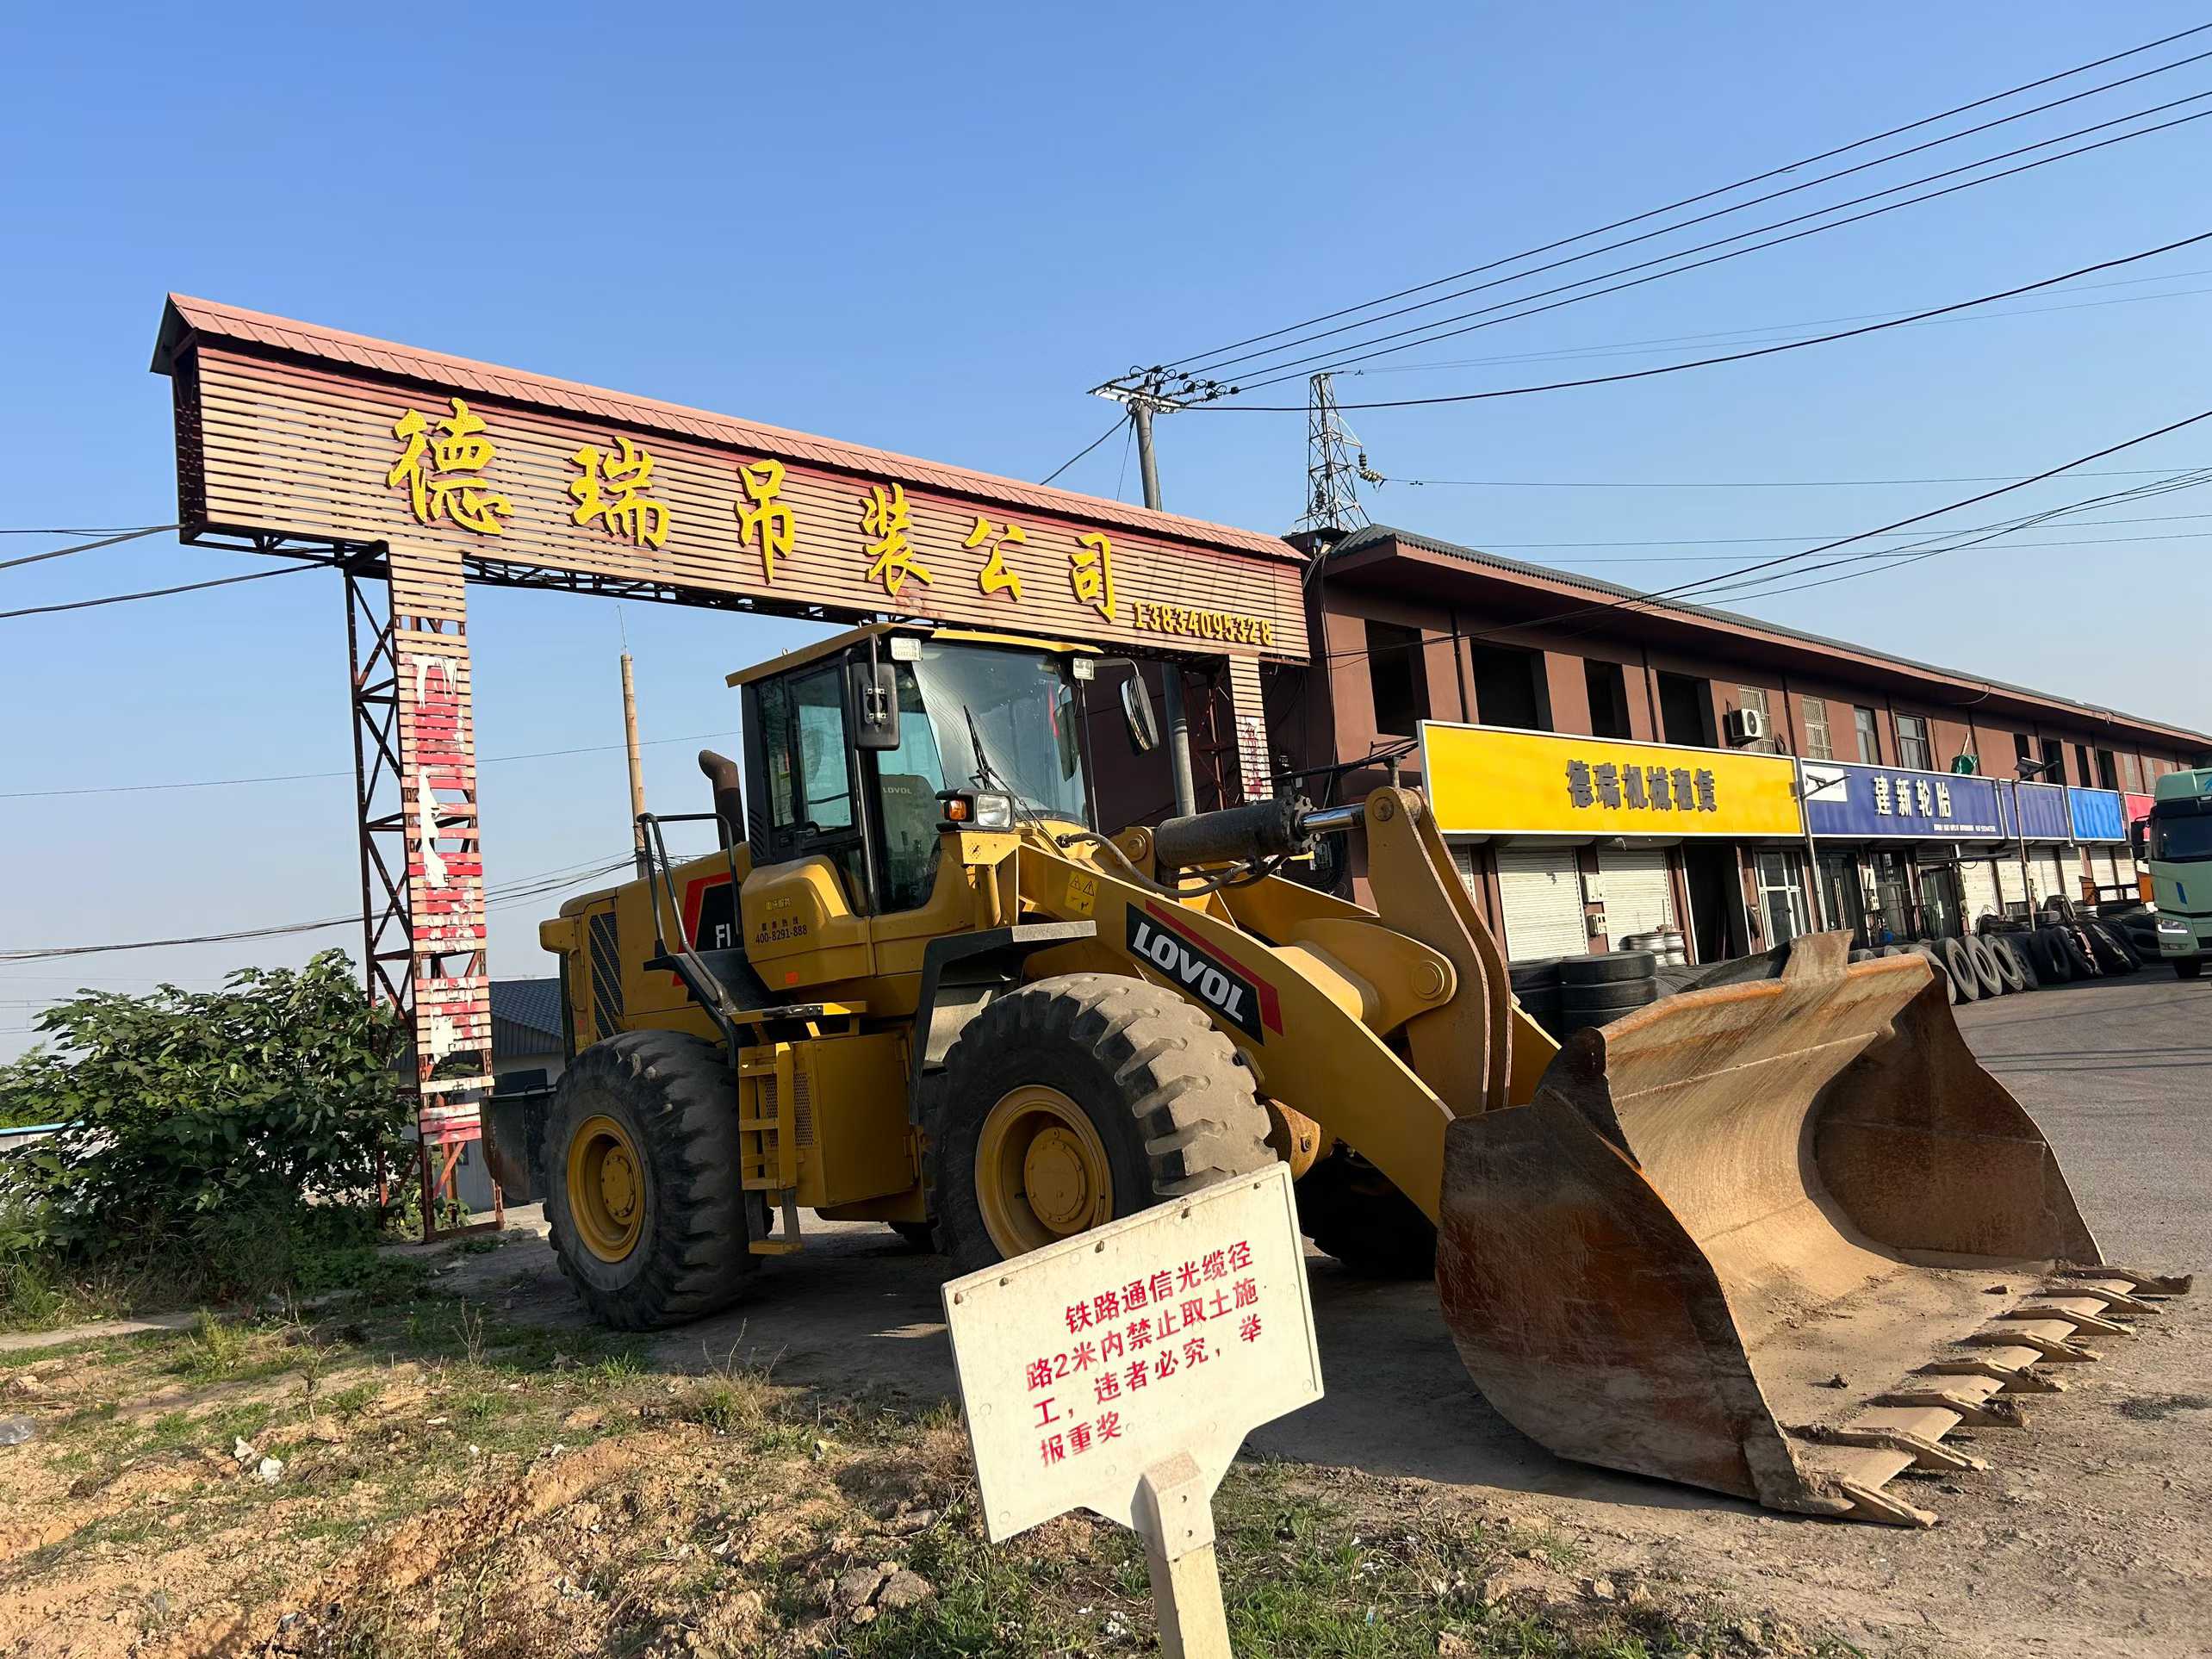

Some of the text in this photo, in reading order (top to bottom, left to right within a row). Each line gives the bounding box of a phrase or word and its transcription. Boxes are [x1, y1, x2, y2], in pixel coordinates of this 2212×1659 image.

[387, 397, 1117, 622] 德瑞吊装公司
[1133, 600, 1274, 646] 13834095328
[1565, 760, 1717, 812] 德瑞机械租赁
[1873, 775, 1952, 817] 建新轮胎
[755, 924, 808, 944] 400-8291-888
[1132, 921, 1244, 1022] LOVOL
[1064, 1239, 1254, 1335] 铁路通信光缆径
[1024, 1277, 1259, 1393] 路2米内禁止取土施
[1038, 1411, 1123, 1469] 报重奖
